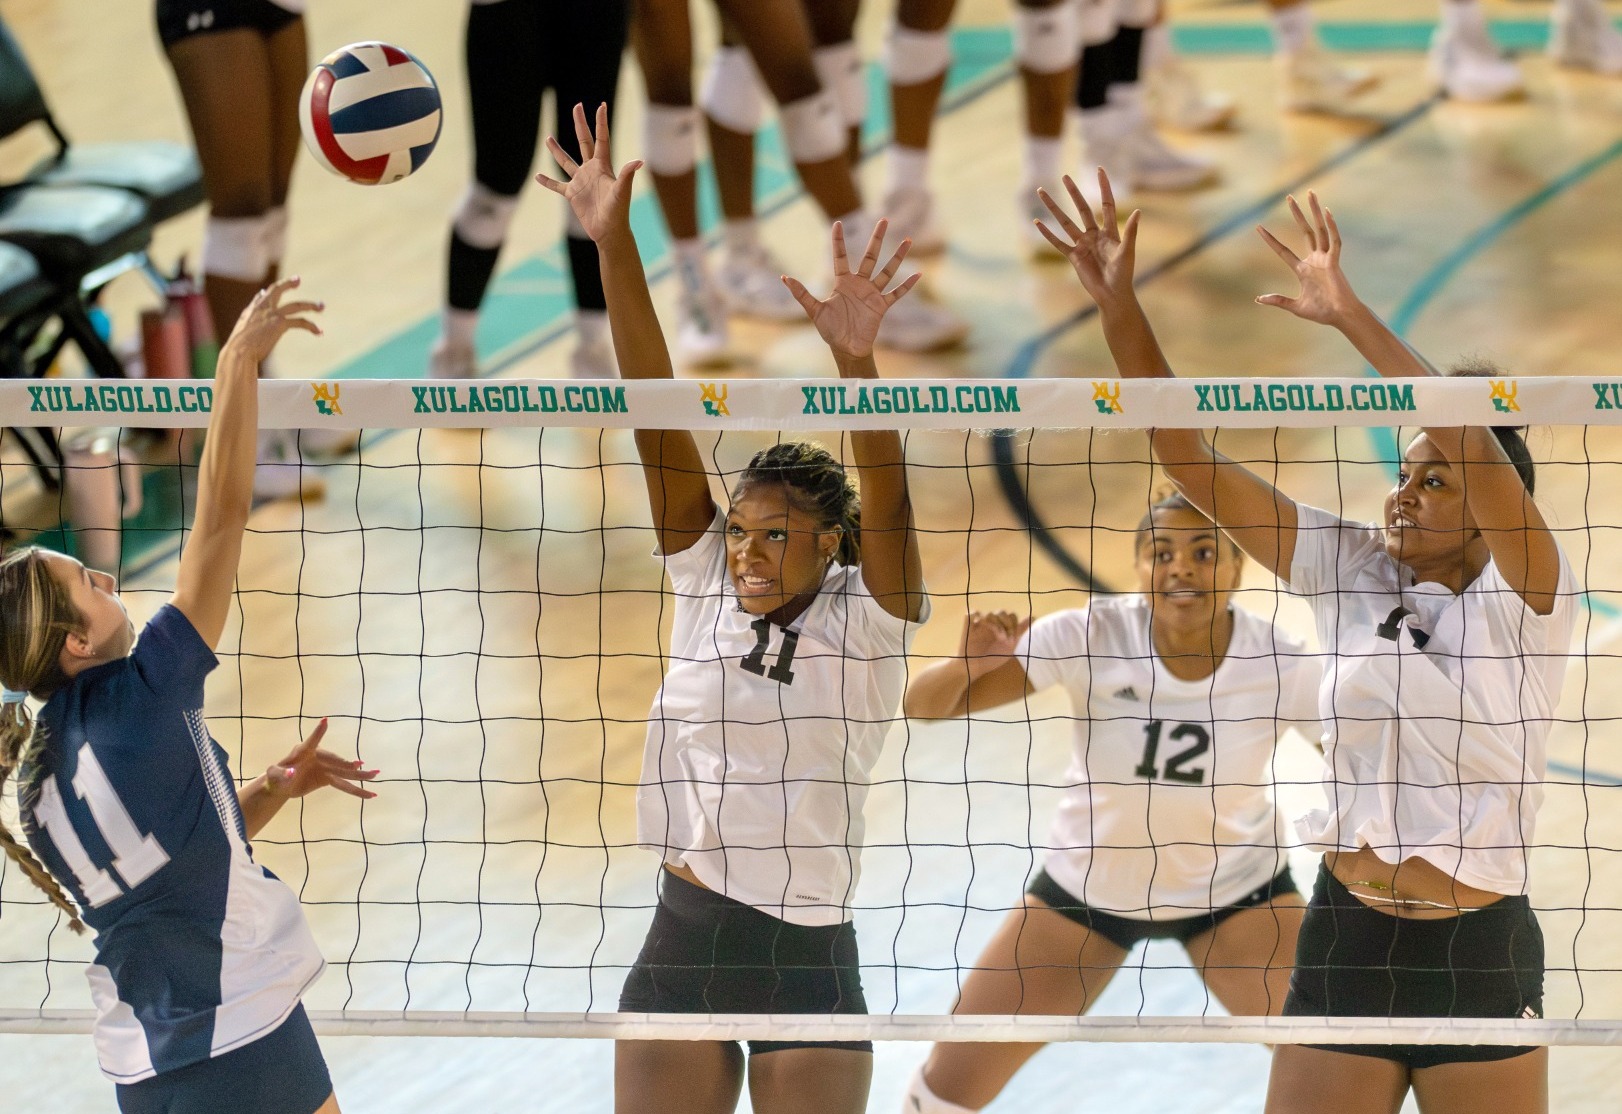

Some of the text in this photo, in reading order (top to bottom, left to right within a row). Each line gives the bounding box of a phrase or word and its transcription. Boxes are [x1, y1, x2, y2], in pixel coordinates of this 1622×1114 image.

[28, 386, 213, 413] XULAGOLD.CO
[412, 386, 628, 414] XULAGOLD.COM
[801, 386, 1020, 415] XULAGOLD.COM
[1195, 384, 1416, 411] XULAGOLD.COM
[740, 619, 799, 686] 11
[1135, 719, 1210, 784] 12
[33, 742, 171, 908] 11
